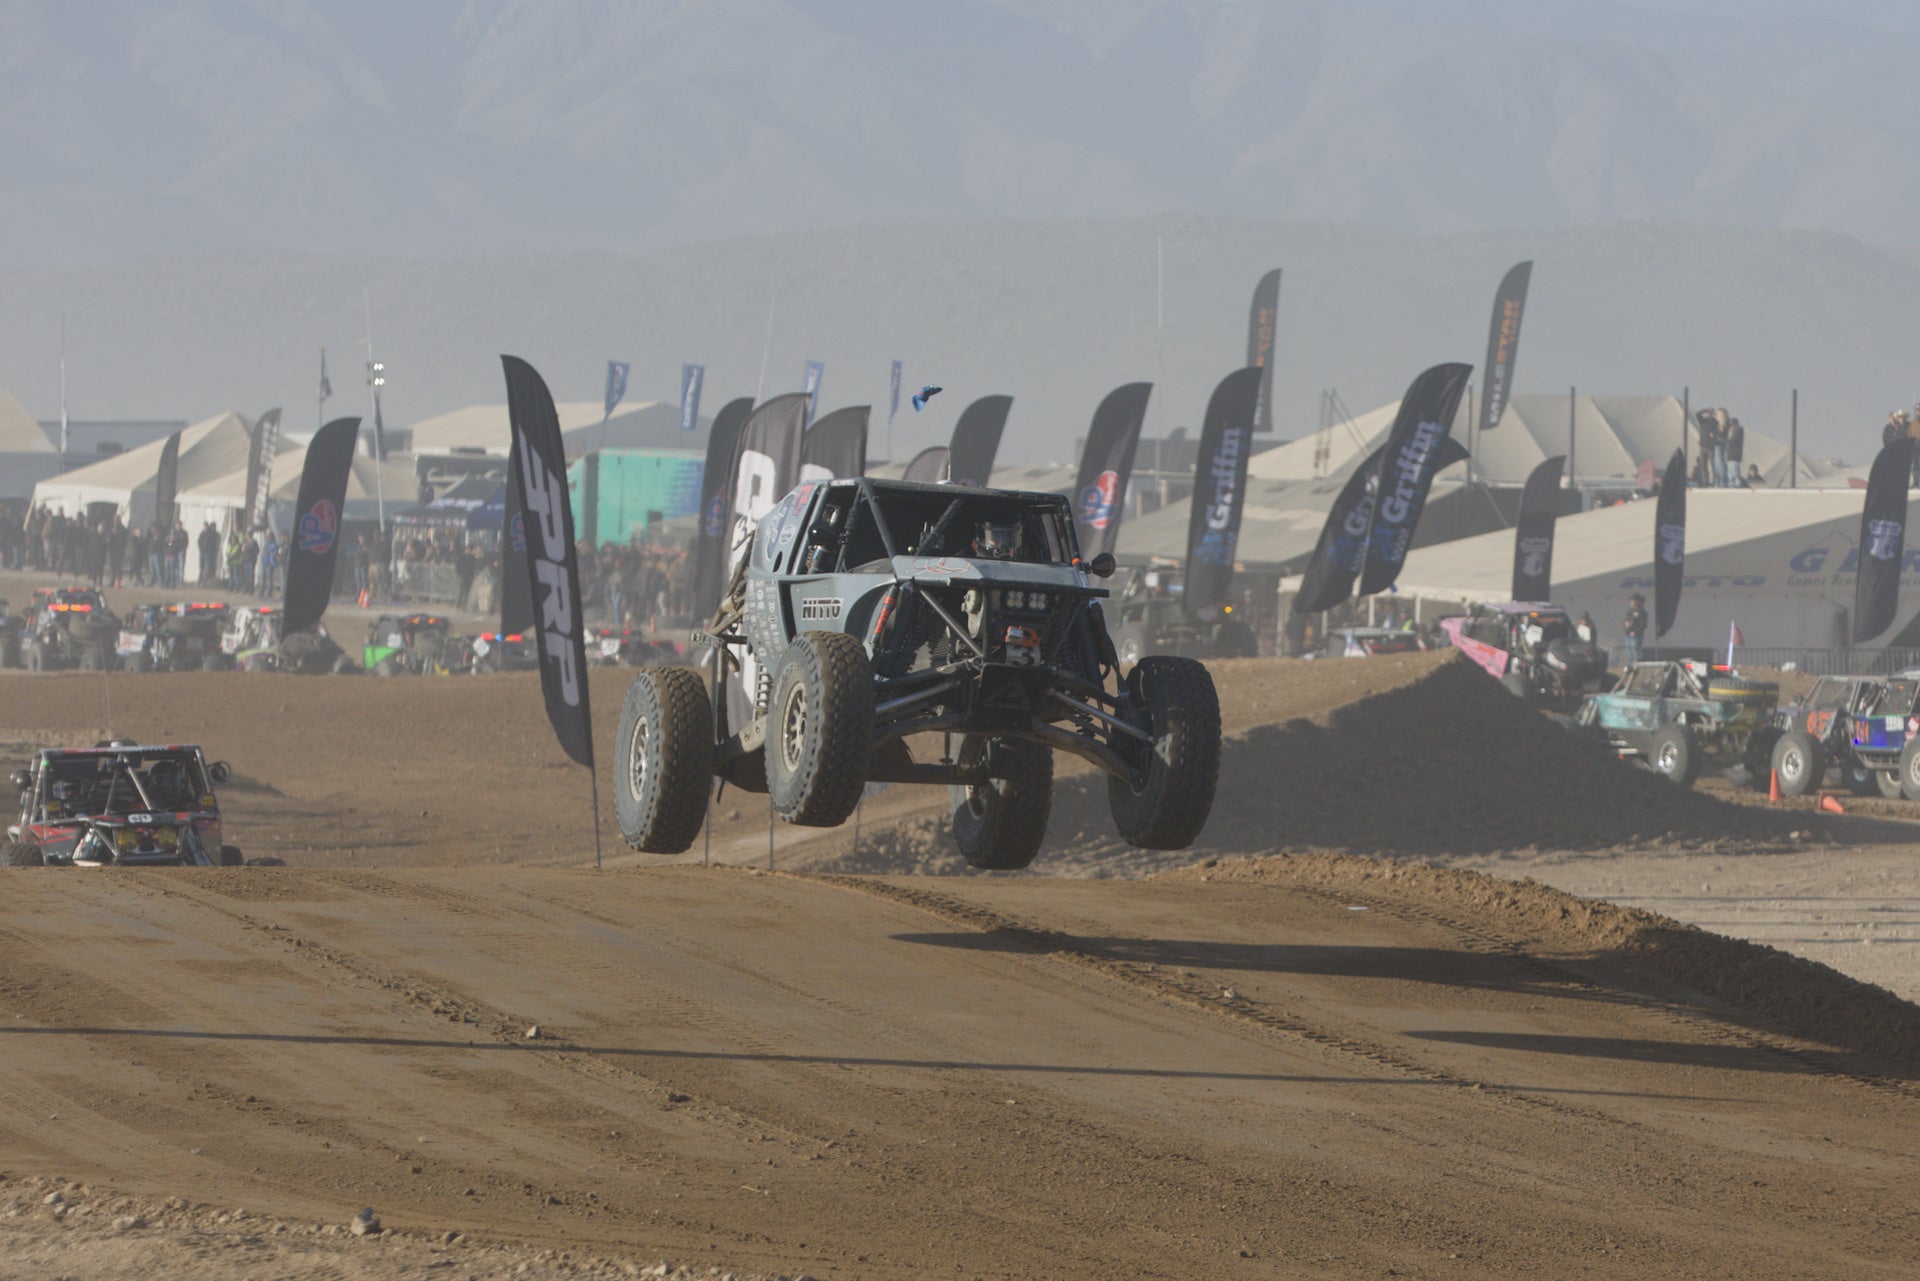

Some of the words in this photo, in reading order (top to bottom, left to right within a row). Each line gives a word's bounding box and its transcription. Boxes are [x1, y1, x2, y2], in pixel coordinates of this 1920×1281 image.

[1205, 427, 1241, 530] Griffin
[1381, 421, 1437, 523] Griffin
[802, 597, 844, 620] NITTO
